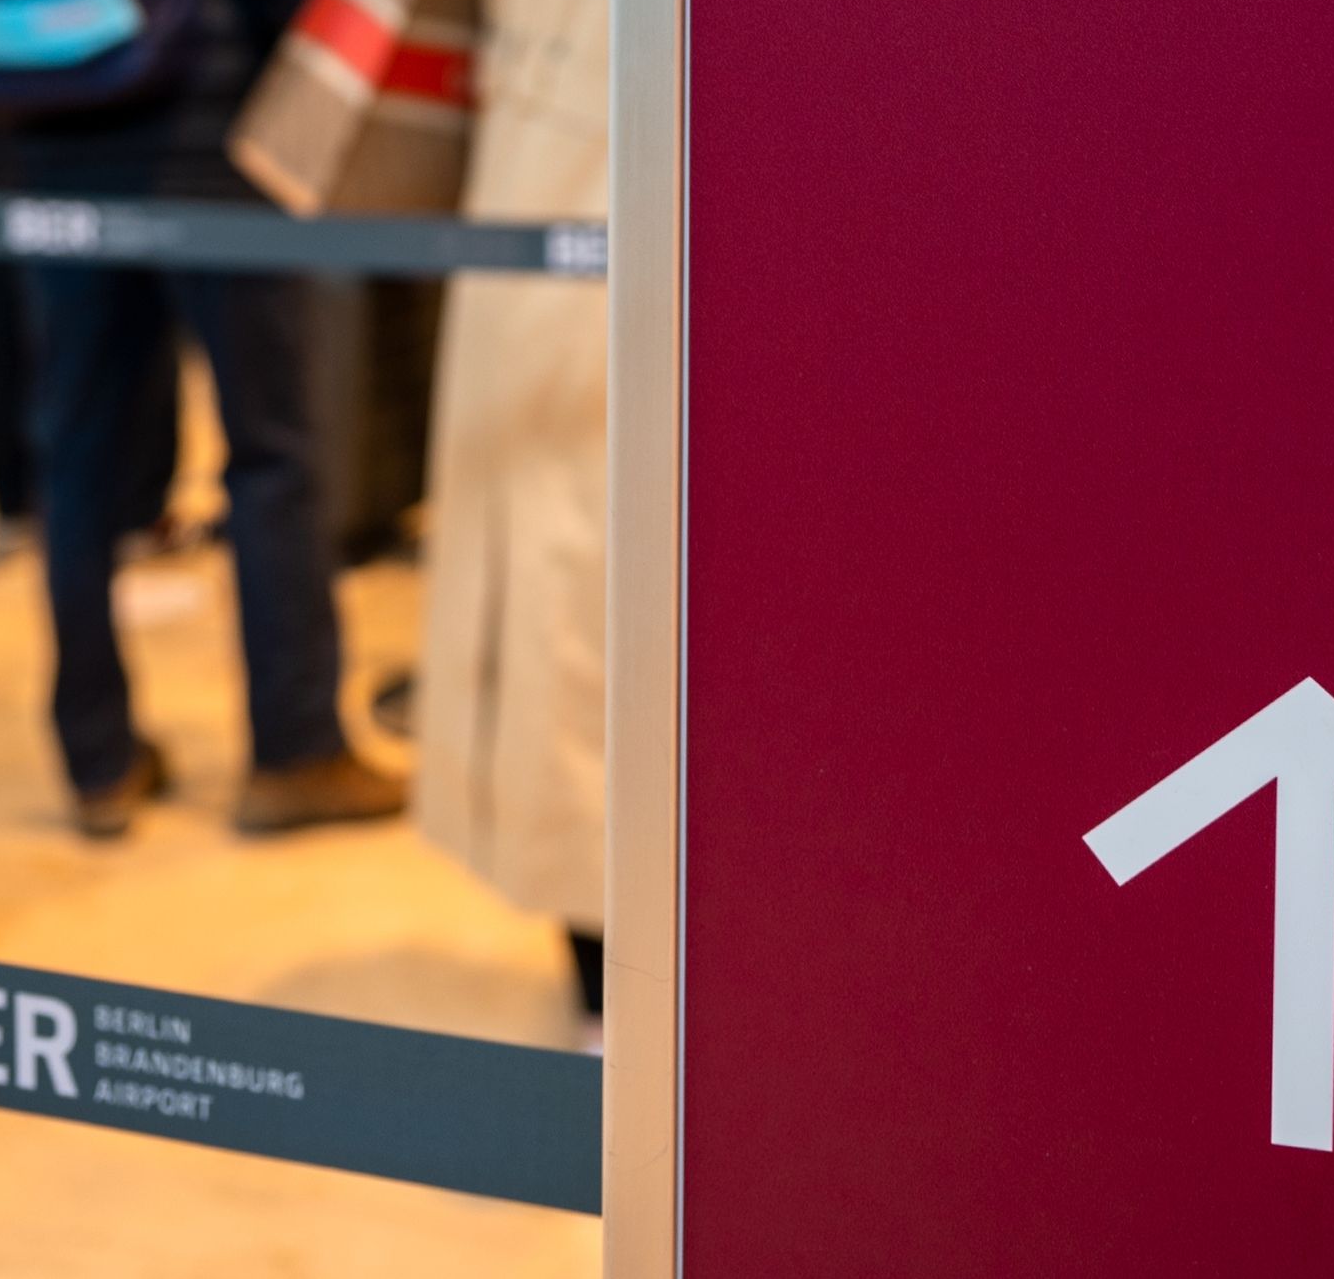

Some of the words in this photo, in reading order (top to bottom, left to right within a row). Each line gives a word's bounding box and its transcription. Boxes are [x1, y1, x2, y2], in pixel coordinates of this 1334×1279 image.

[93, 1003, 192, 1045] BERLIN
[94, 1039, 306, 1101] BRANDENBURG
[93, 1076, 214, 1122] AIRPORT
